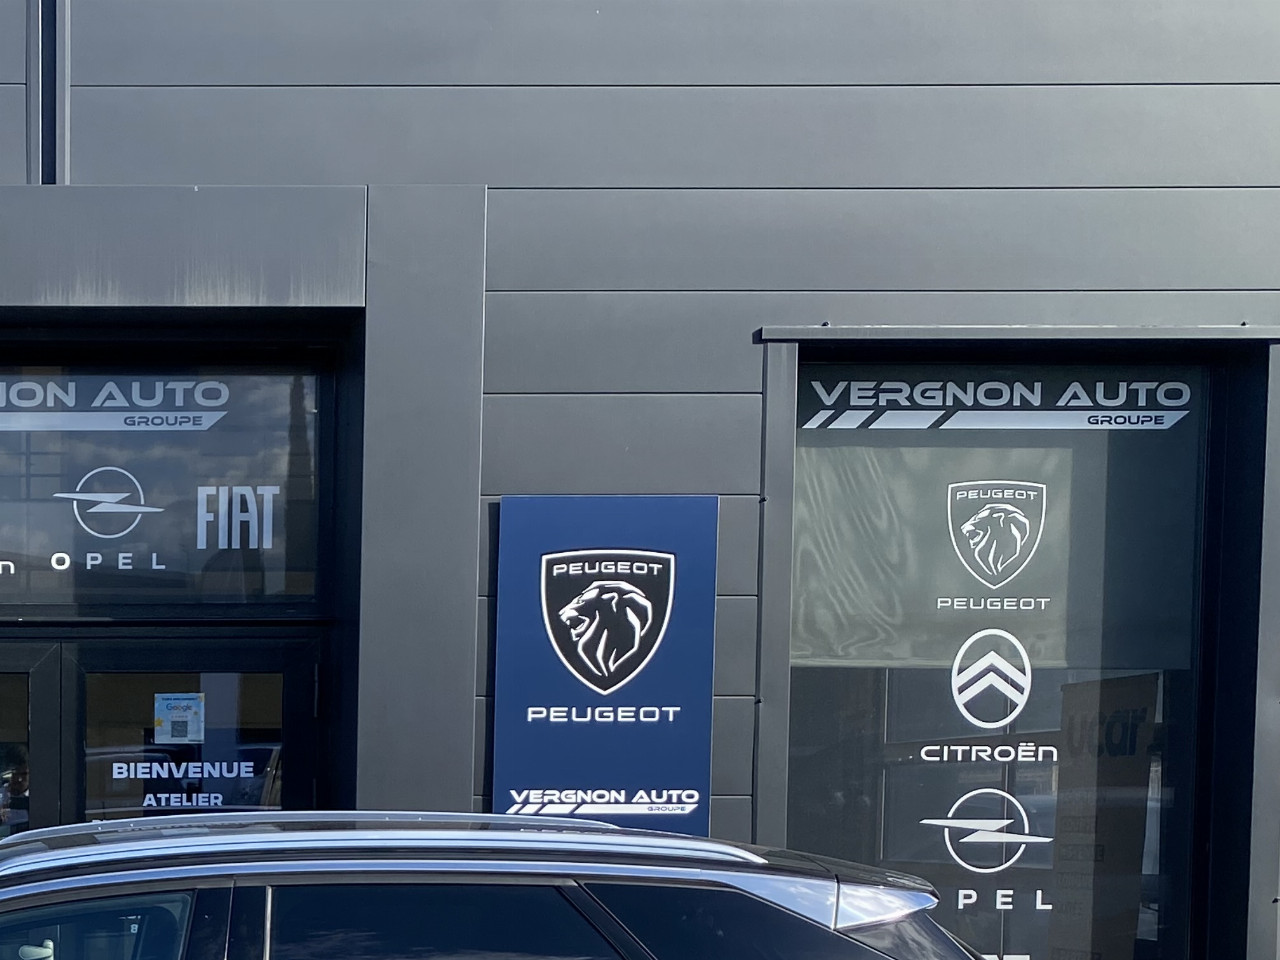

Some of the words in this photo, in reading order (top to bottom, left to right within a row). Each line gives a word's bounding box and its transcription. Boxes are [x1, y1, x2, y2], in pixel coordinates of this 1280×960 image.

[91, 381, 230, 408] AUTO
[811, 381, 1041, 407] VERGNON
[1056, 381, 1191, 407] AUTO
[123, 415, 204, 427] GROUPE
[1087, 414, 1165, 426] GROUPE
[956, 489, 1038, 500] PEUGEOT
[196, 485, 280, 549] FIAT
[51, 552, 166, 570] OPEL
[553, 561, 663, 577] PEUGEOT
[937, 598, 1051, 610] PEUGEOT
[527, 706, 681, 722] PEUGEOT
[920, 742, 1058, 762] CITROËN
[112, 762, 255, 779] BIENVENUE
[142, 793, 223, 807] ATELIER
[510, 789, 626, 803] VERGNON
[631, 789, 700, 803] AUTO
[927, 889, 1054, 911] PEL
